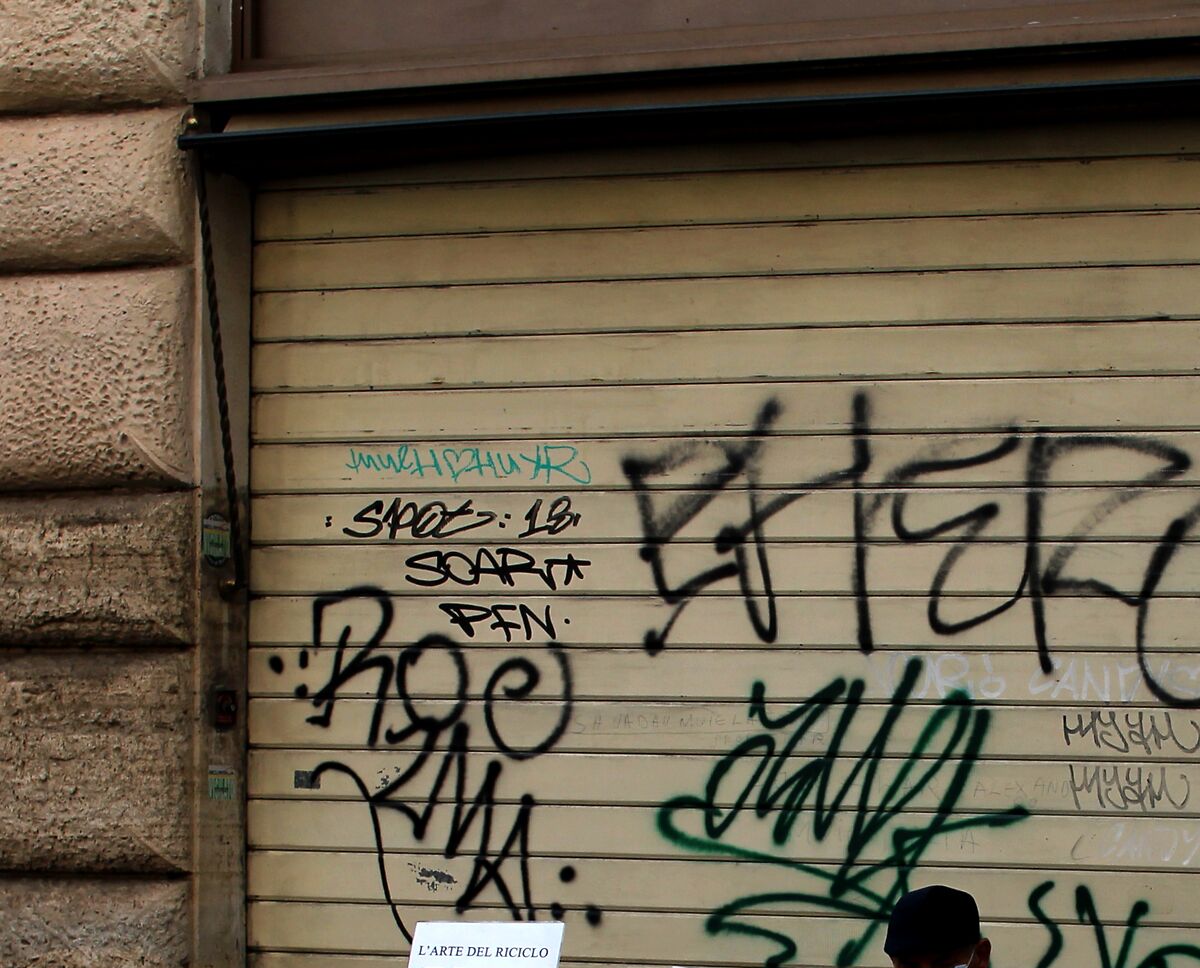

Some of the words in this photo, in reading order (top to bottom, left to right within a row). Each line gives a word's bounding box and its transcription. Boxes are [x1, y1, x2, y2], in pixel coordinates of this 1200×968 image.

[418, 944, 464, 957] L'ARTE
[466, 946, 492, 958] DEL
[495, 947, 549, 958] RICICLO
